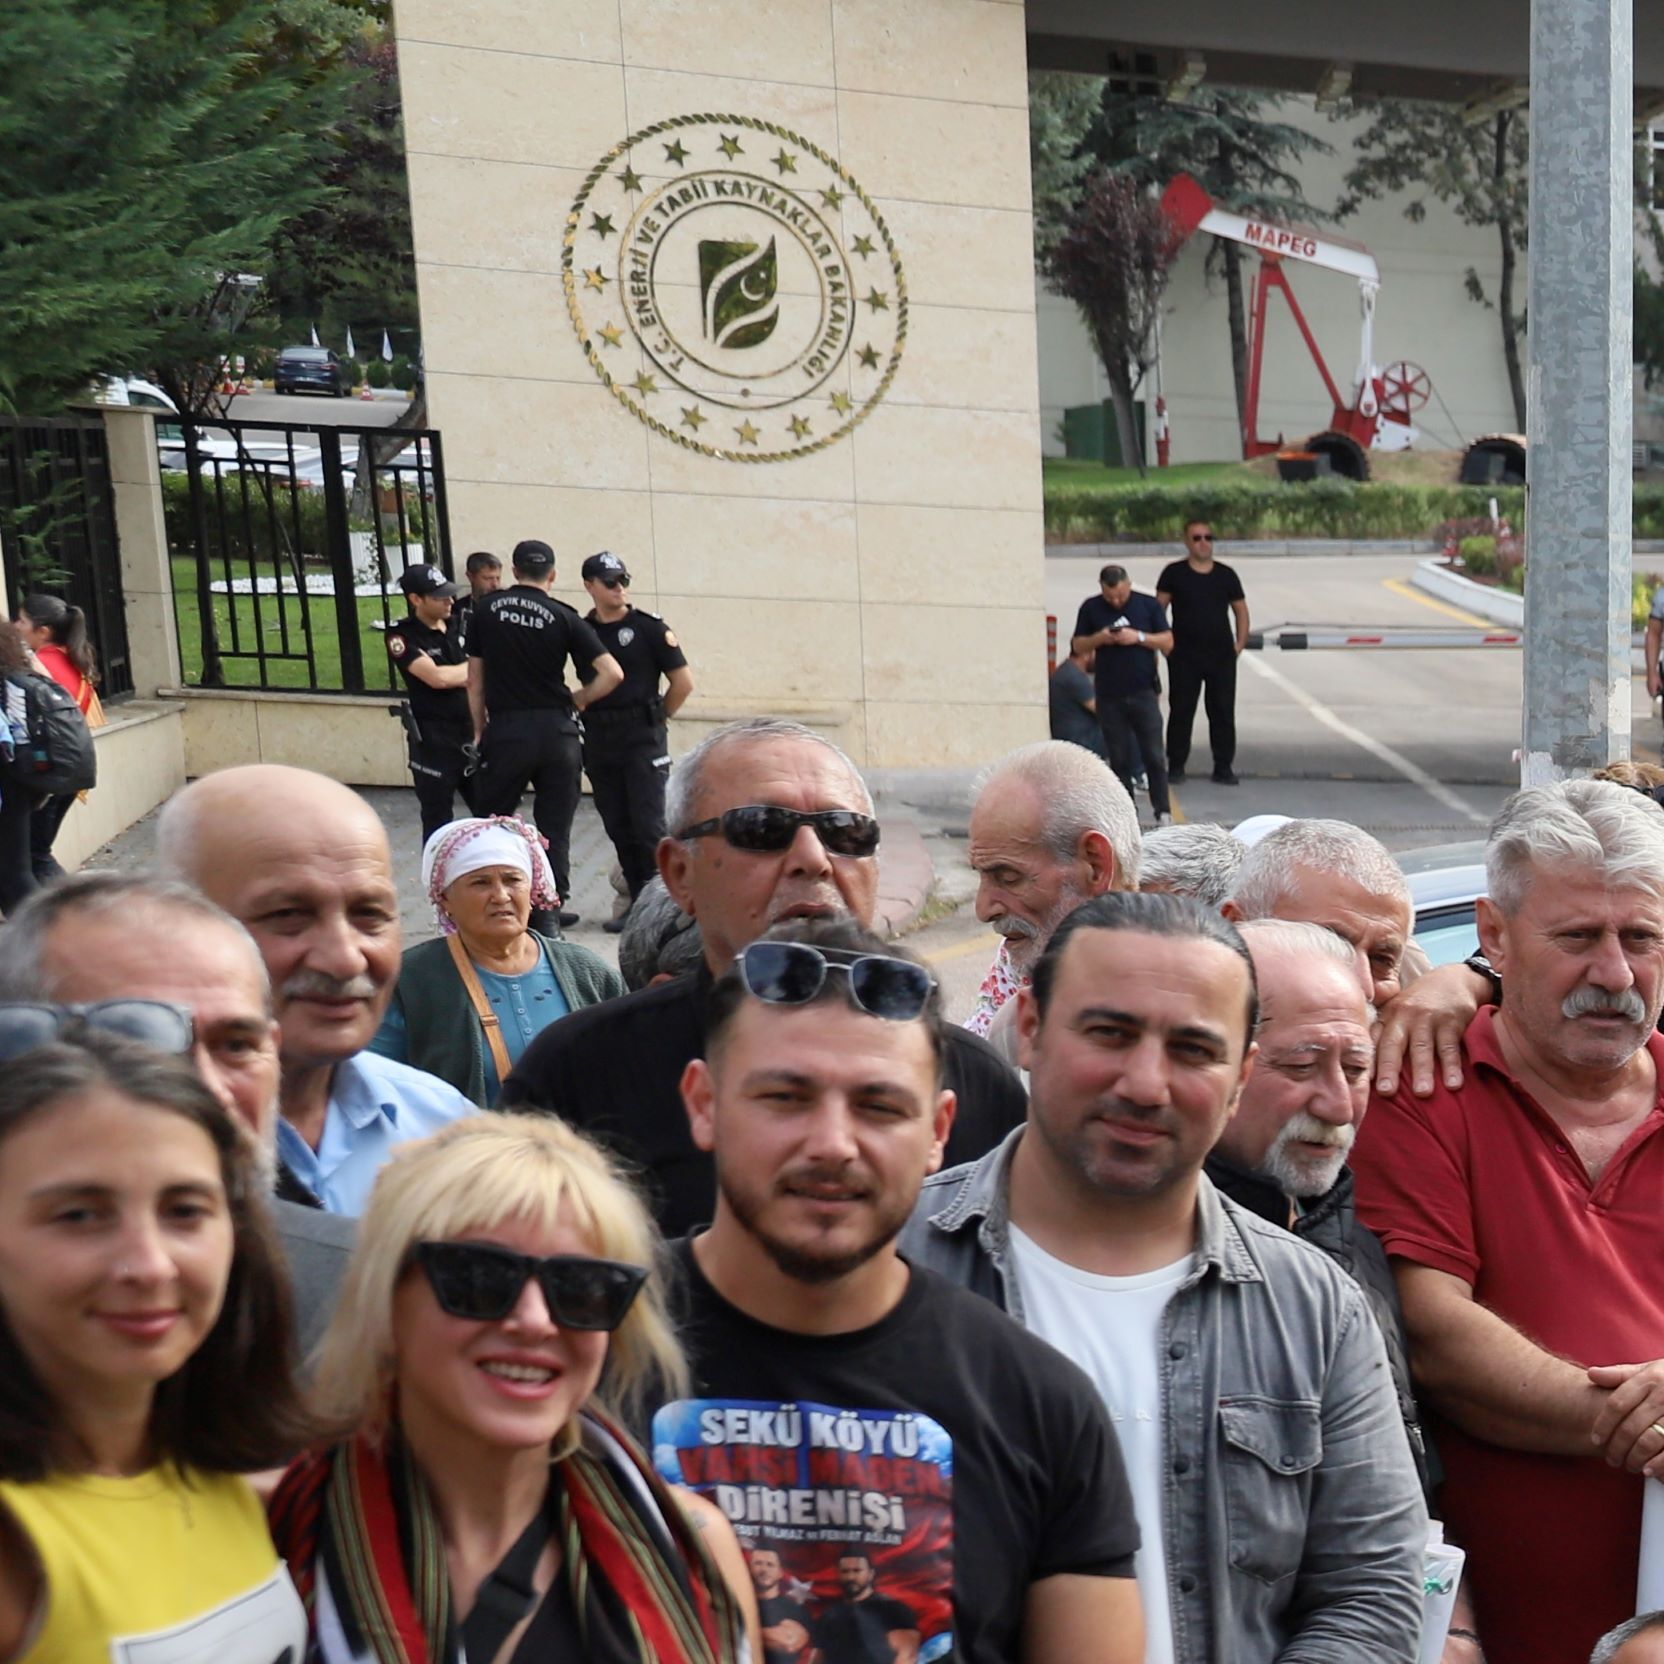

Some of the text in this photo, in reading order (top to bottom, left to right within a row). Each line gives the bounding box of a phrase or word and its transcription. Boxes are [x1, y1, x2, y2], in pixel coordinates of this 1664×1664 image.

[637, 216, 661, 245] VE
[714, 179, 832, 260] KAYNAKLAR
[1245, 223, 1317, 257] MAPEG
[701, 1403, 919, 1457] SEKÜ KÖYÜ
